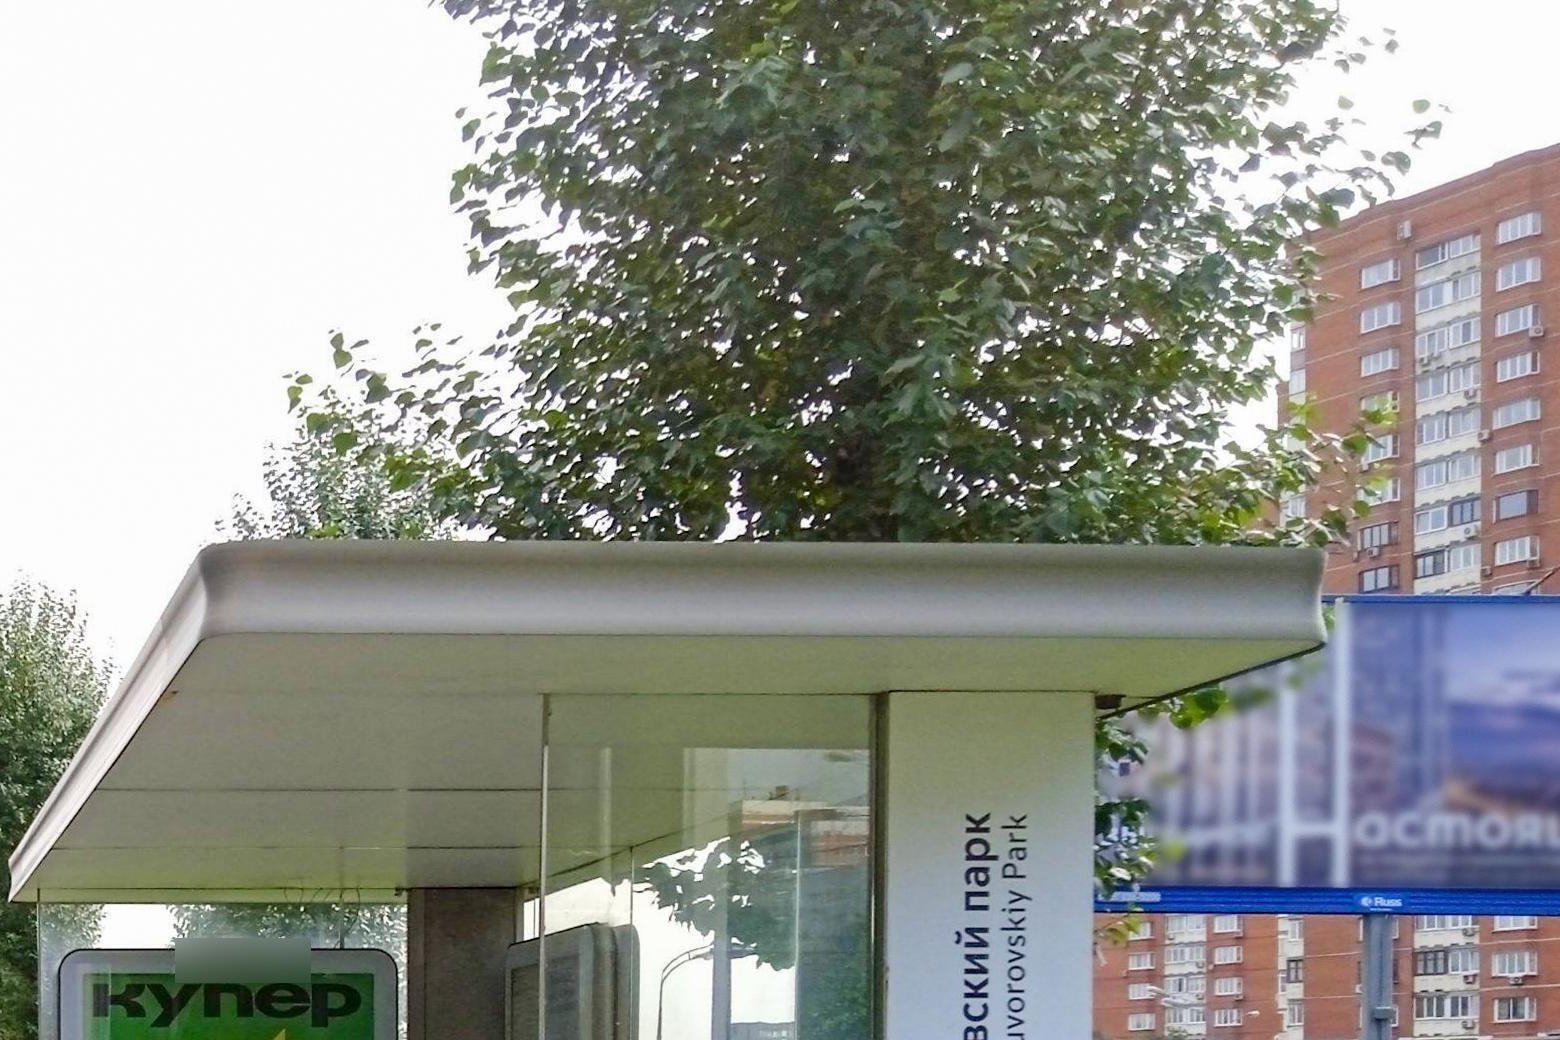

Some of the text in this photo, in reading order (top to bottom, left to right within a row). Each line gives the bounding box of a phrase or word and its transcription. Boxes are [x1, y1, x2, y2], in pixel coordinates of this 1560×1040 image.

[963, 811, 1000, 913] парк
[1000, 813, 1030, 879] Park
[1374, 896, 1403, 907] Russ
[92, 982, 362, 1028] купер
